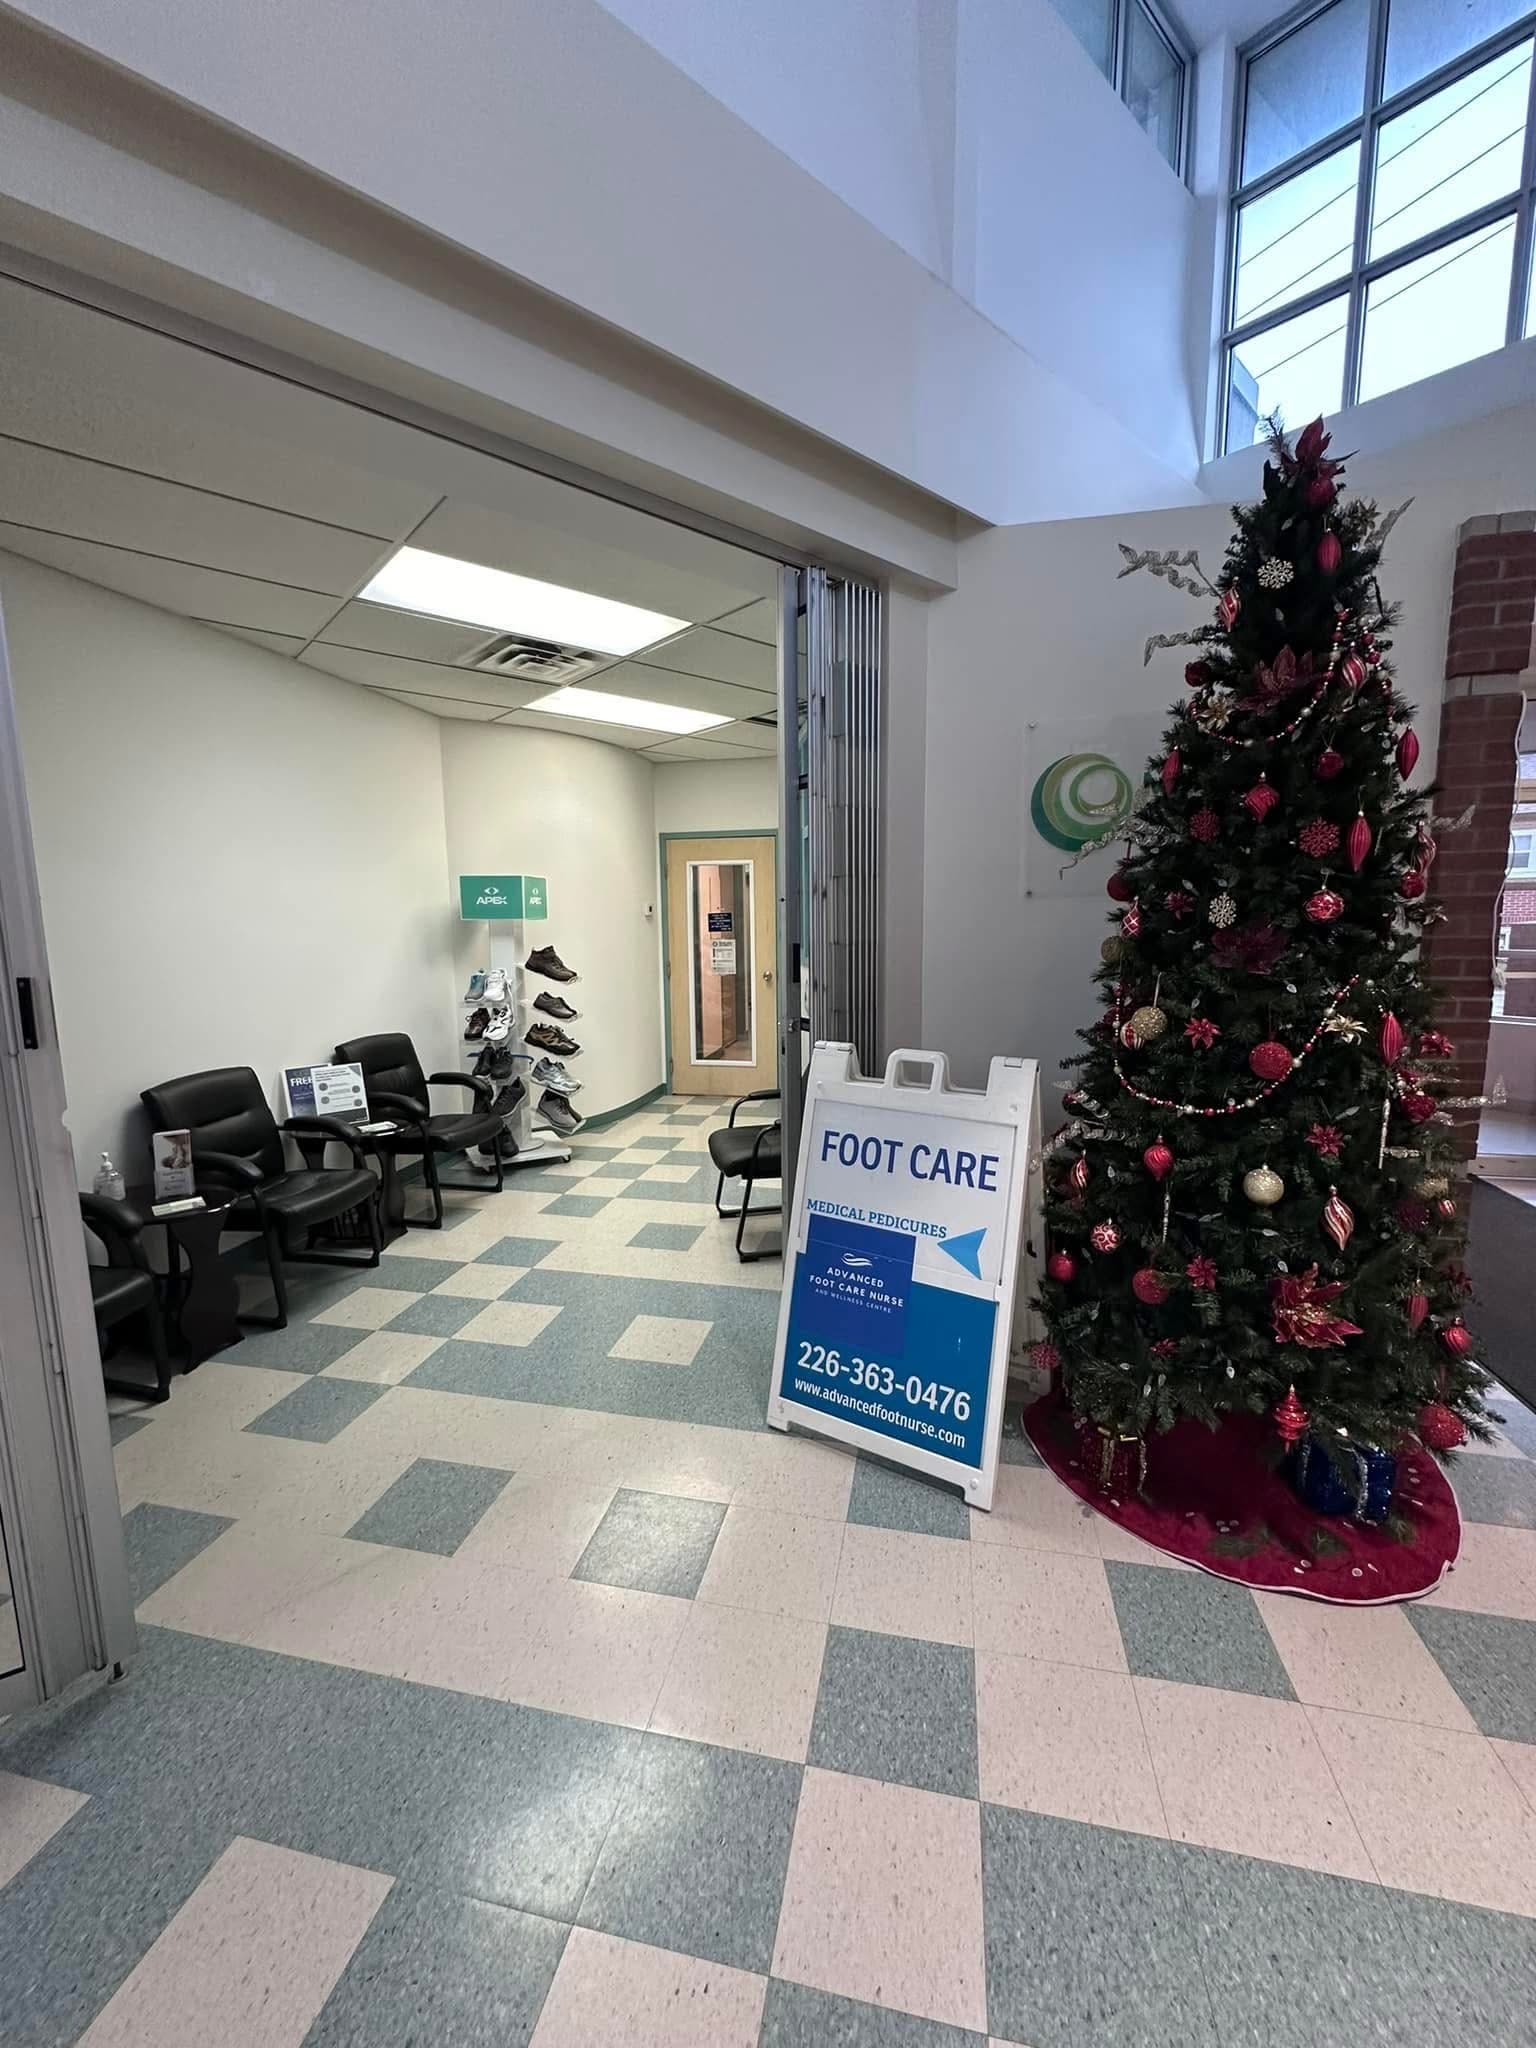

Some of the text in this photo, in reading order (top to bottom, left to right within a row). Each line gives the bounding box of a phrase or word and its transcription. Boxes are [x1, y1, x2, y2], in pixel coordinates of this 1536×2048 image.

[476, 896, 508, 905] APEX
[821, 1129, 1000, 1192] FOOT CARE
[806, 1198, 948, 1239] MEDICAL PEDICURES
[809, 1274, 904, 1307] FOOT CARE NURSE
[826, 1266, 885, 1288] ADVANCED
[815, 1287, 892, 1314] AND WELLNESS CENTRE
[797, 1341, 972, 1422] 226-363-0476
[794, 1377, 966, 1449] www.advancedfootnurse.com
